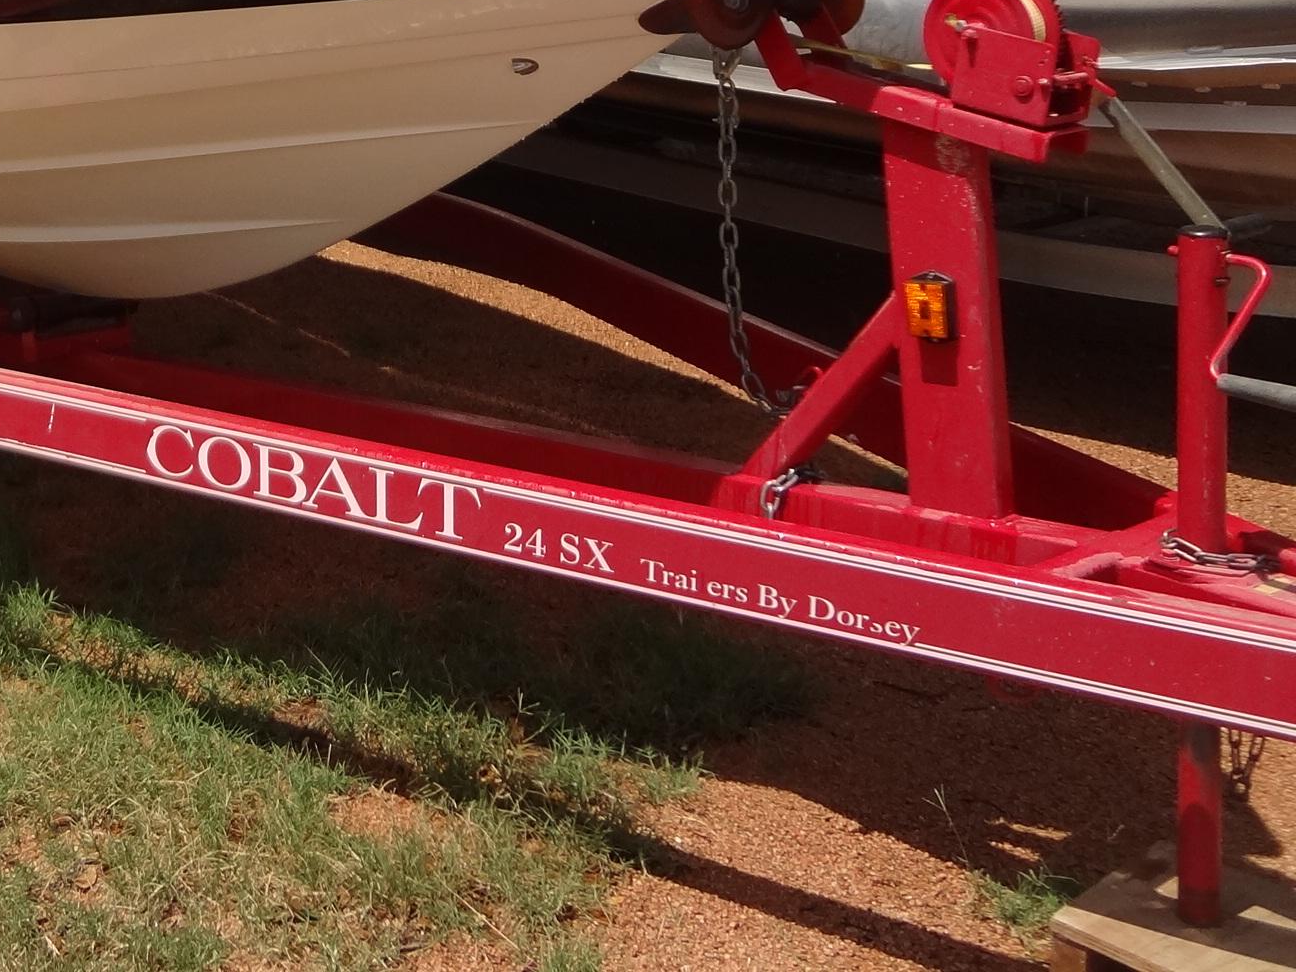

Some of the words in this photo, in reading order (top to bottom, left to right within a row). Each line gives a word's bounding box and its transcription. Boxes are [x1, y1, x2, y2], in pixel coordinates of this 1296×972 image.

[146, 424, 482, 540] COBALT
[503, 522, 547, 558] 24
[560, 532, 615, 573] SX
[640, 557, 748, 603] Traiers
[757, 583, 797, 619] By
